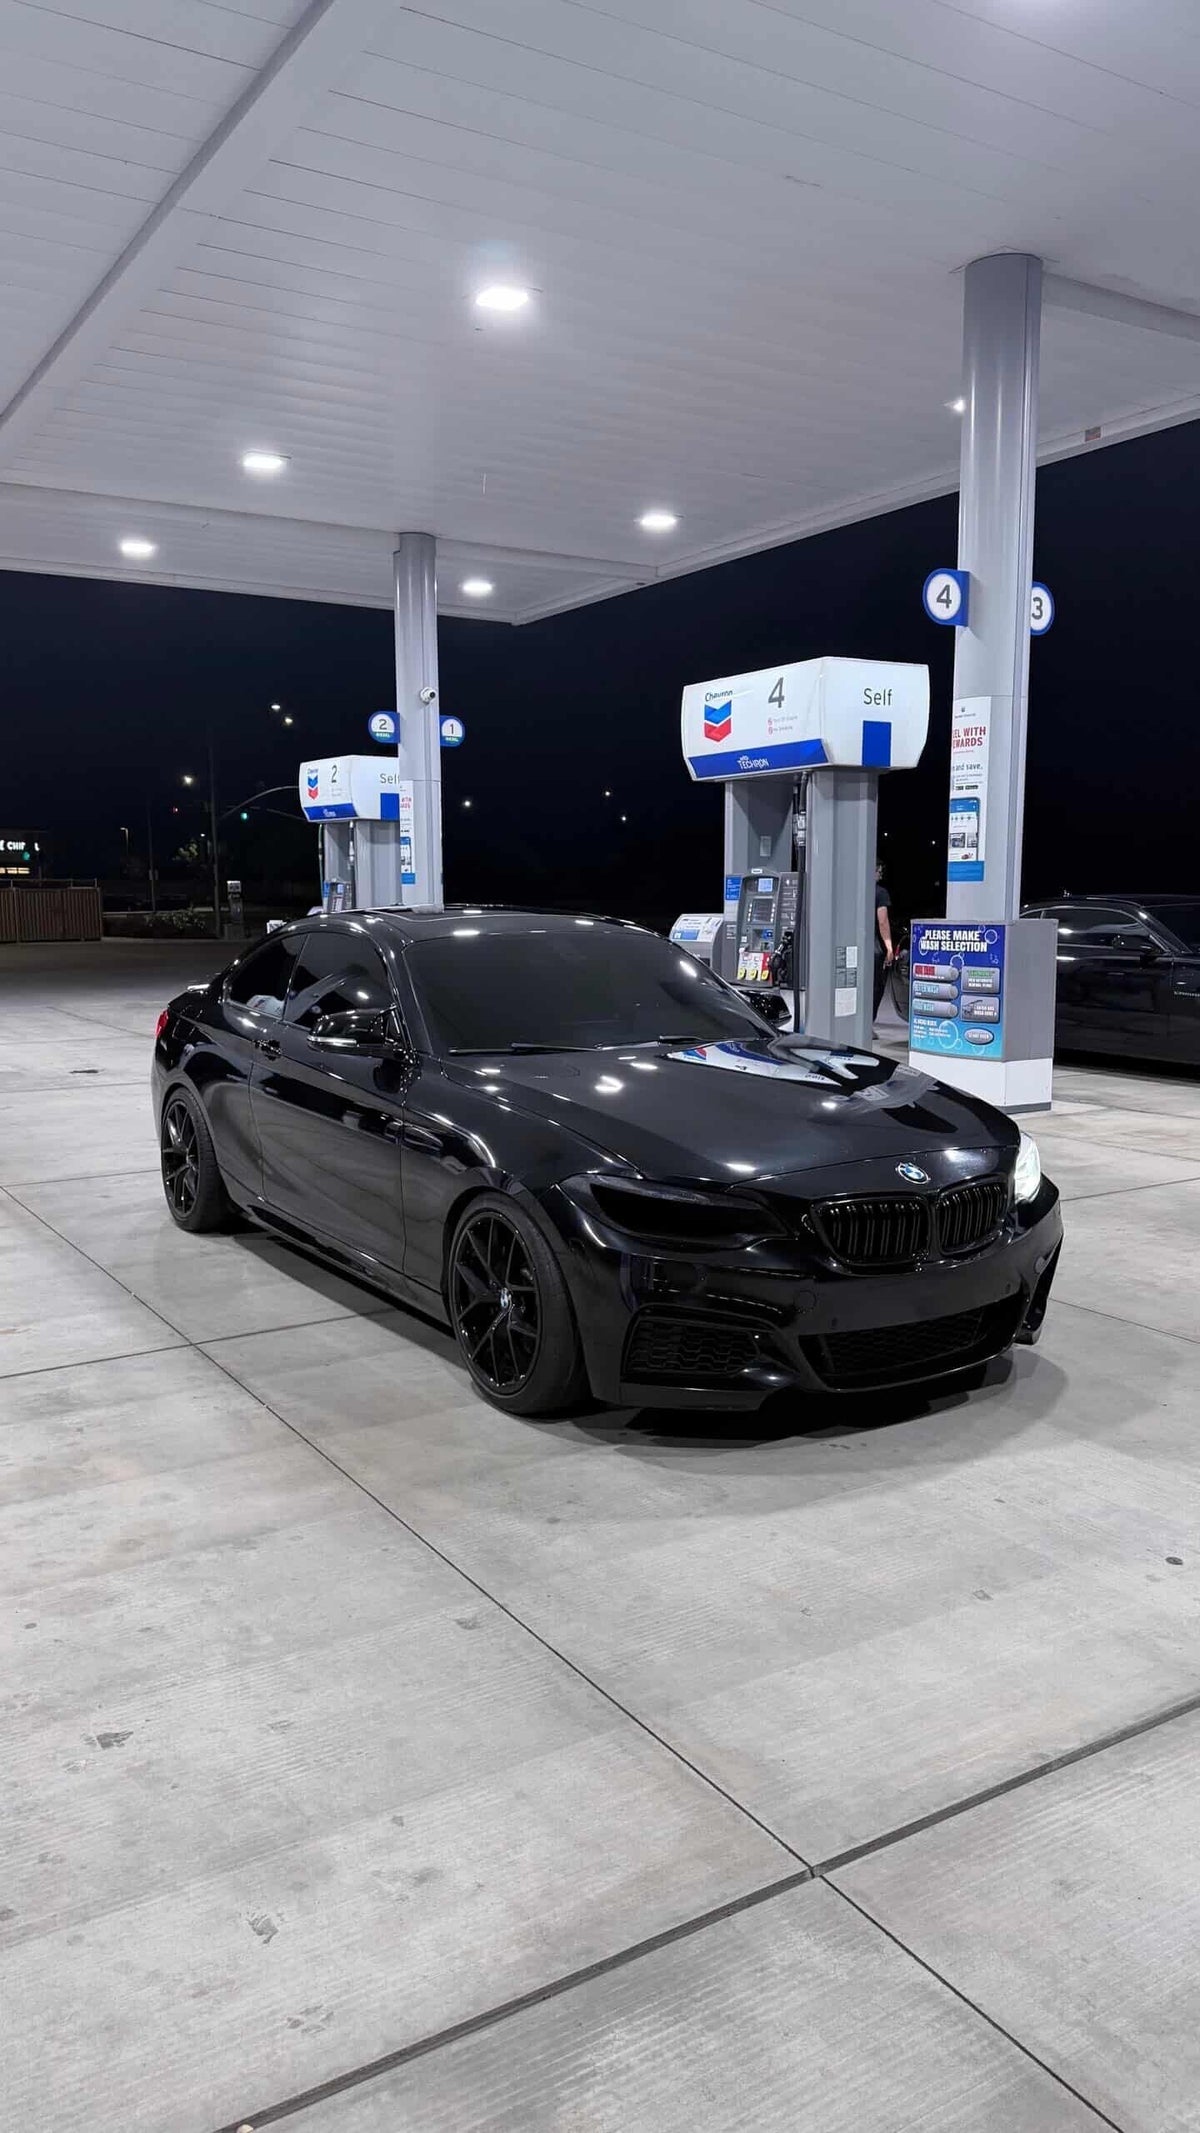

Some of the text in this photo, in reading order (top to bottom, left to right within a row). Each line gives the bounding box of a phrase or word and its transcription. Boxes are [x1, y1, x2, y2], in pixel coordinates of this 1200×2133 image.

[936, 584, 952, 609] 4
[1031, 596, 1044, 620] 3
[768, 677, 785, 708] 4
[864, 688, 892, 705] Self
[379, 719, 387, 730] 2
[449, 723, 455, 735] 1
[963, 726, 986, 737] WITH
[737, 757, 769, 769] TECHRON
[331, 765, 337, 783] 2
[925, 930, 980, 940] PLEASE MAKE
[920, 940, 987, 952] WASH SELECTION
